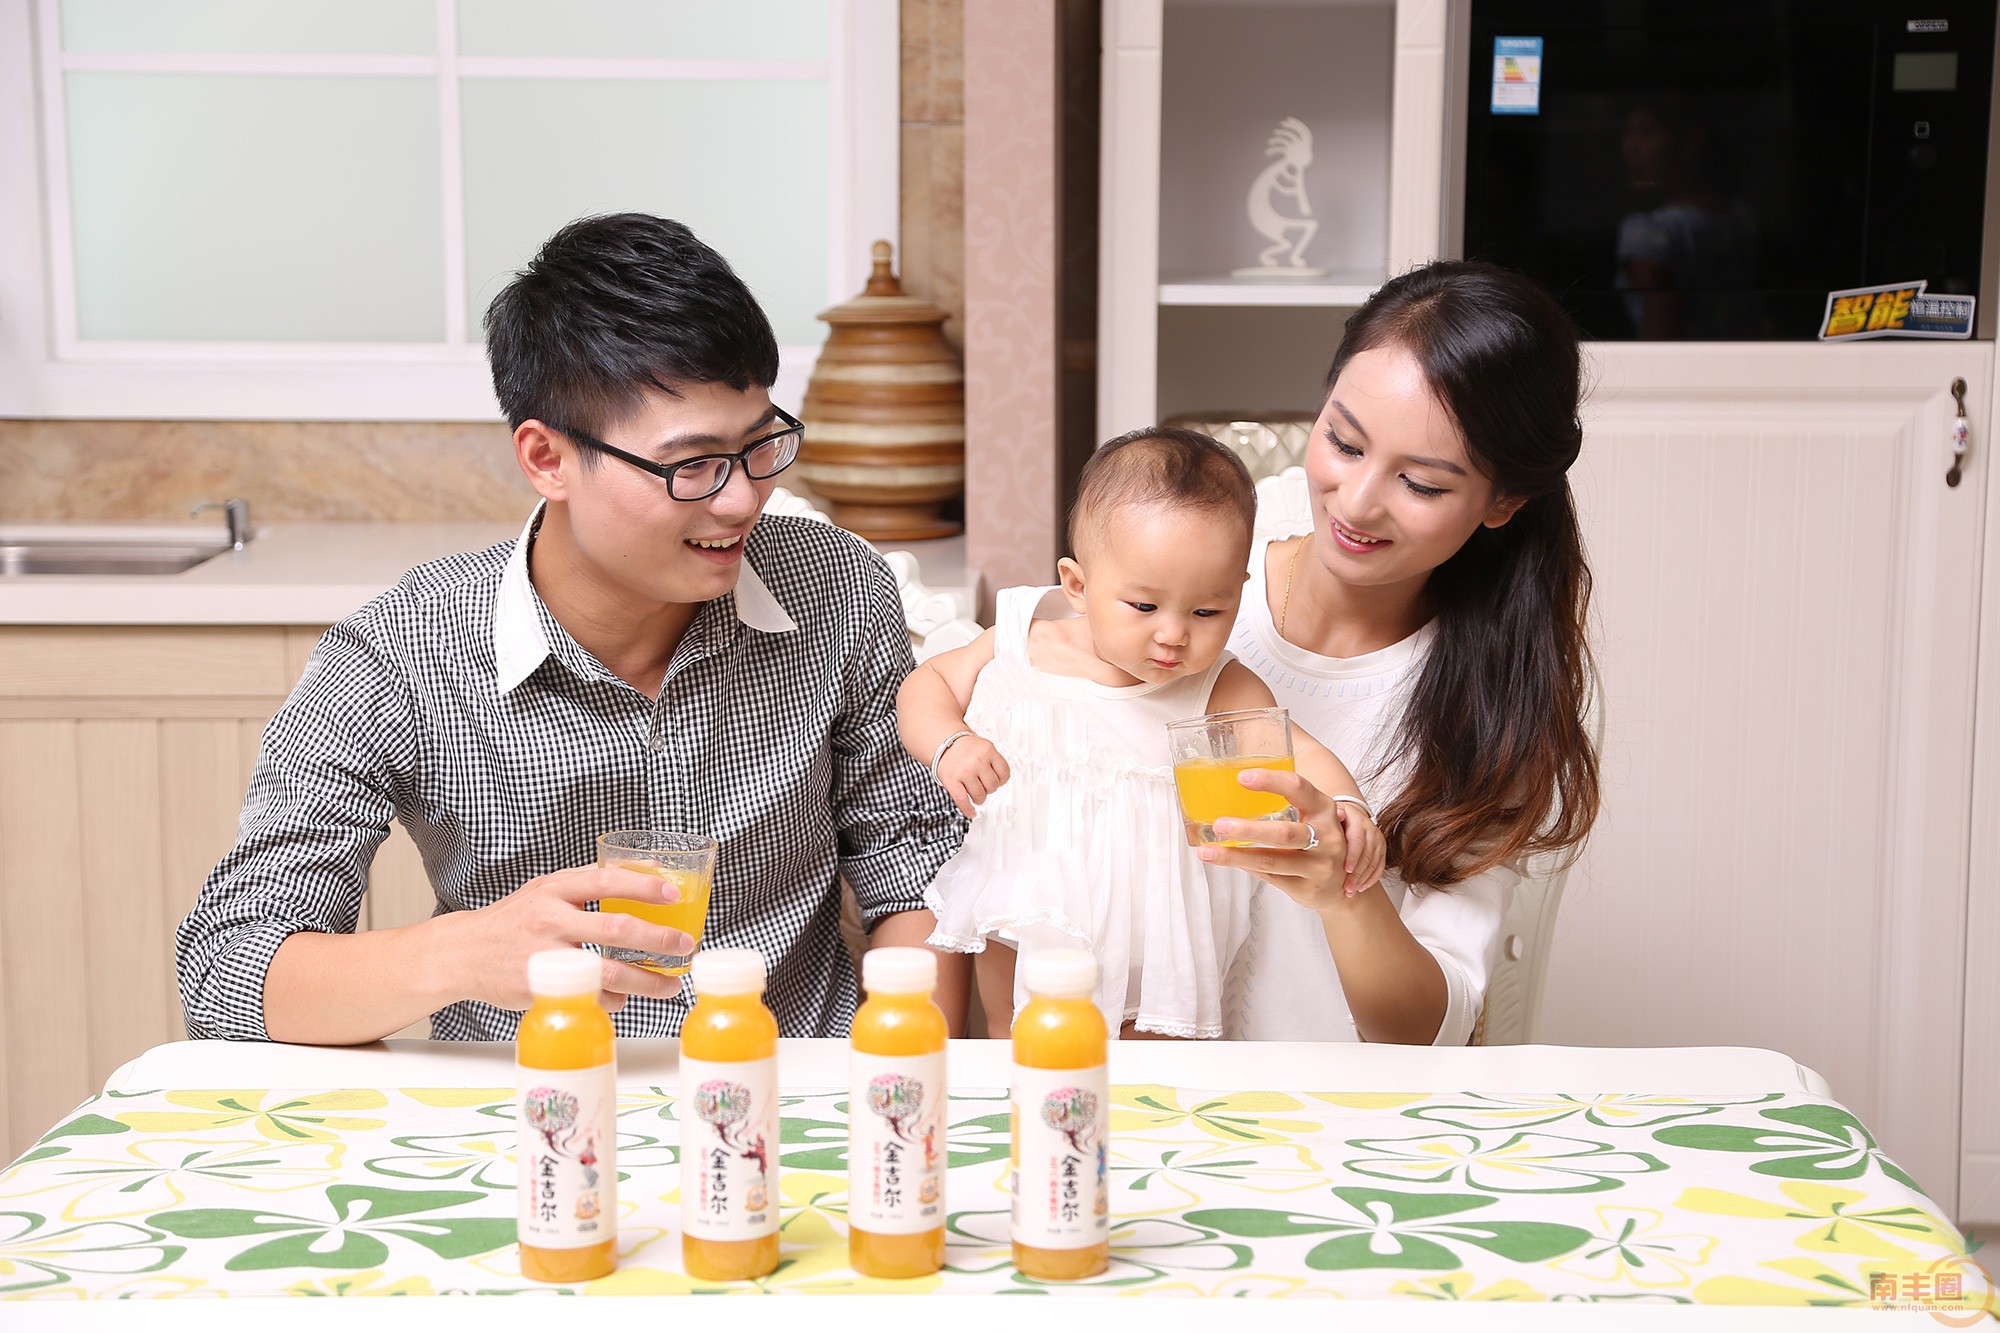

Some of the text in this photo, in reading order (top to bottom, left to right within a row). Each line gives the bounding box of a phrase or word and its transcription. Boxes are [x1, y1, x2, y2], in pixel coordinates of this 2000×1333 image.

[1826, 289, 1916, 335] 智能
[539, 1155, 559, 1222] 金吉尔
[710, 1147, 731, 1214] 金吉尔
[884, 1141, 904, 1208] 金吉尔
[1061, 1155, 1082, 1222] 金吉尔
